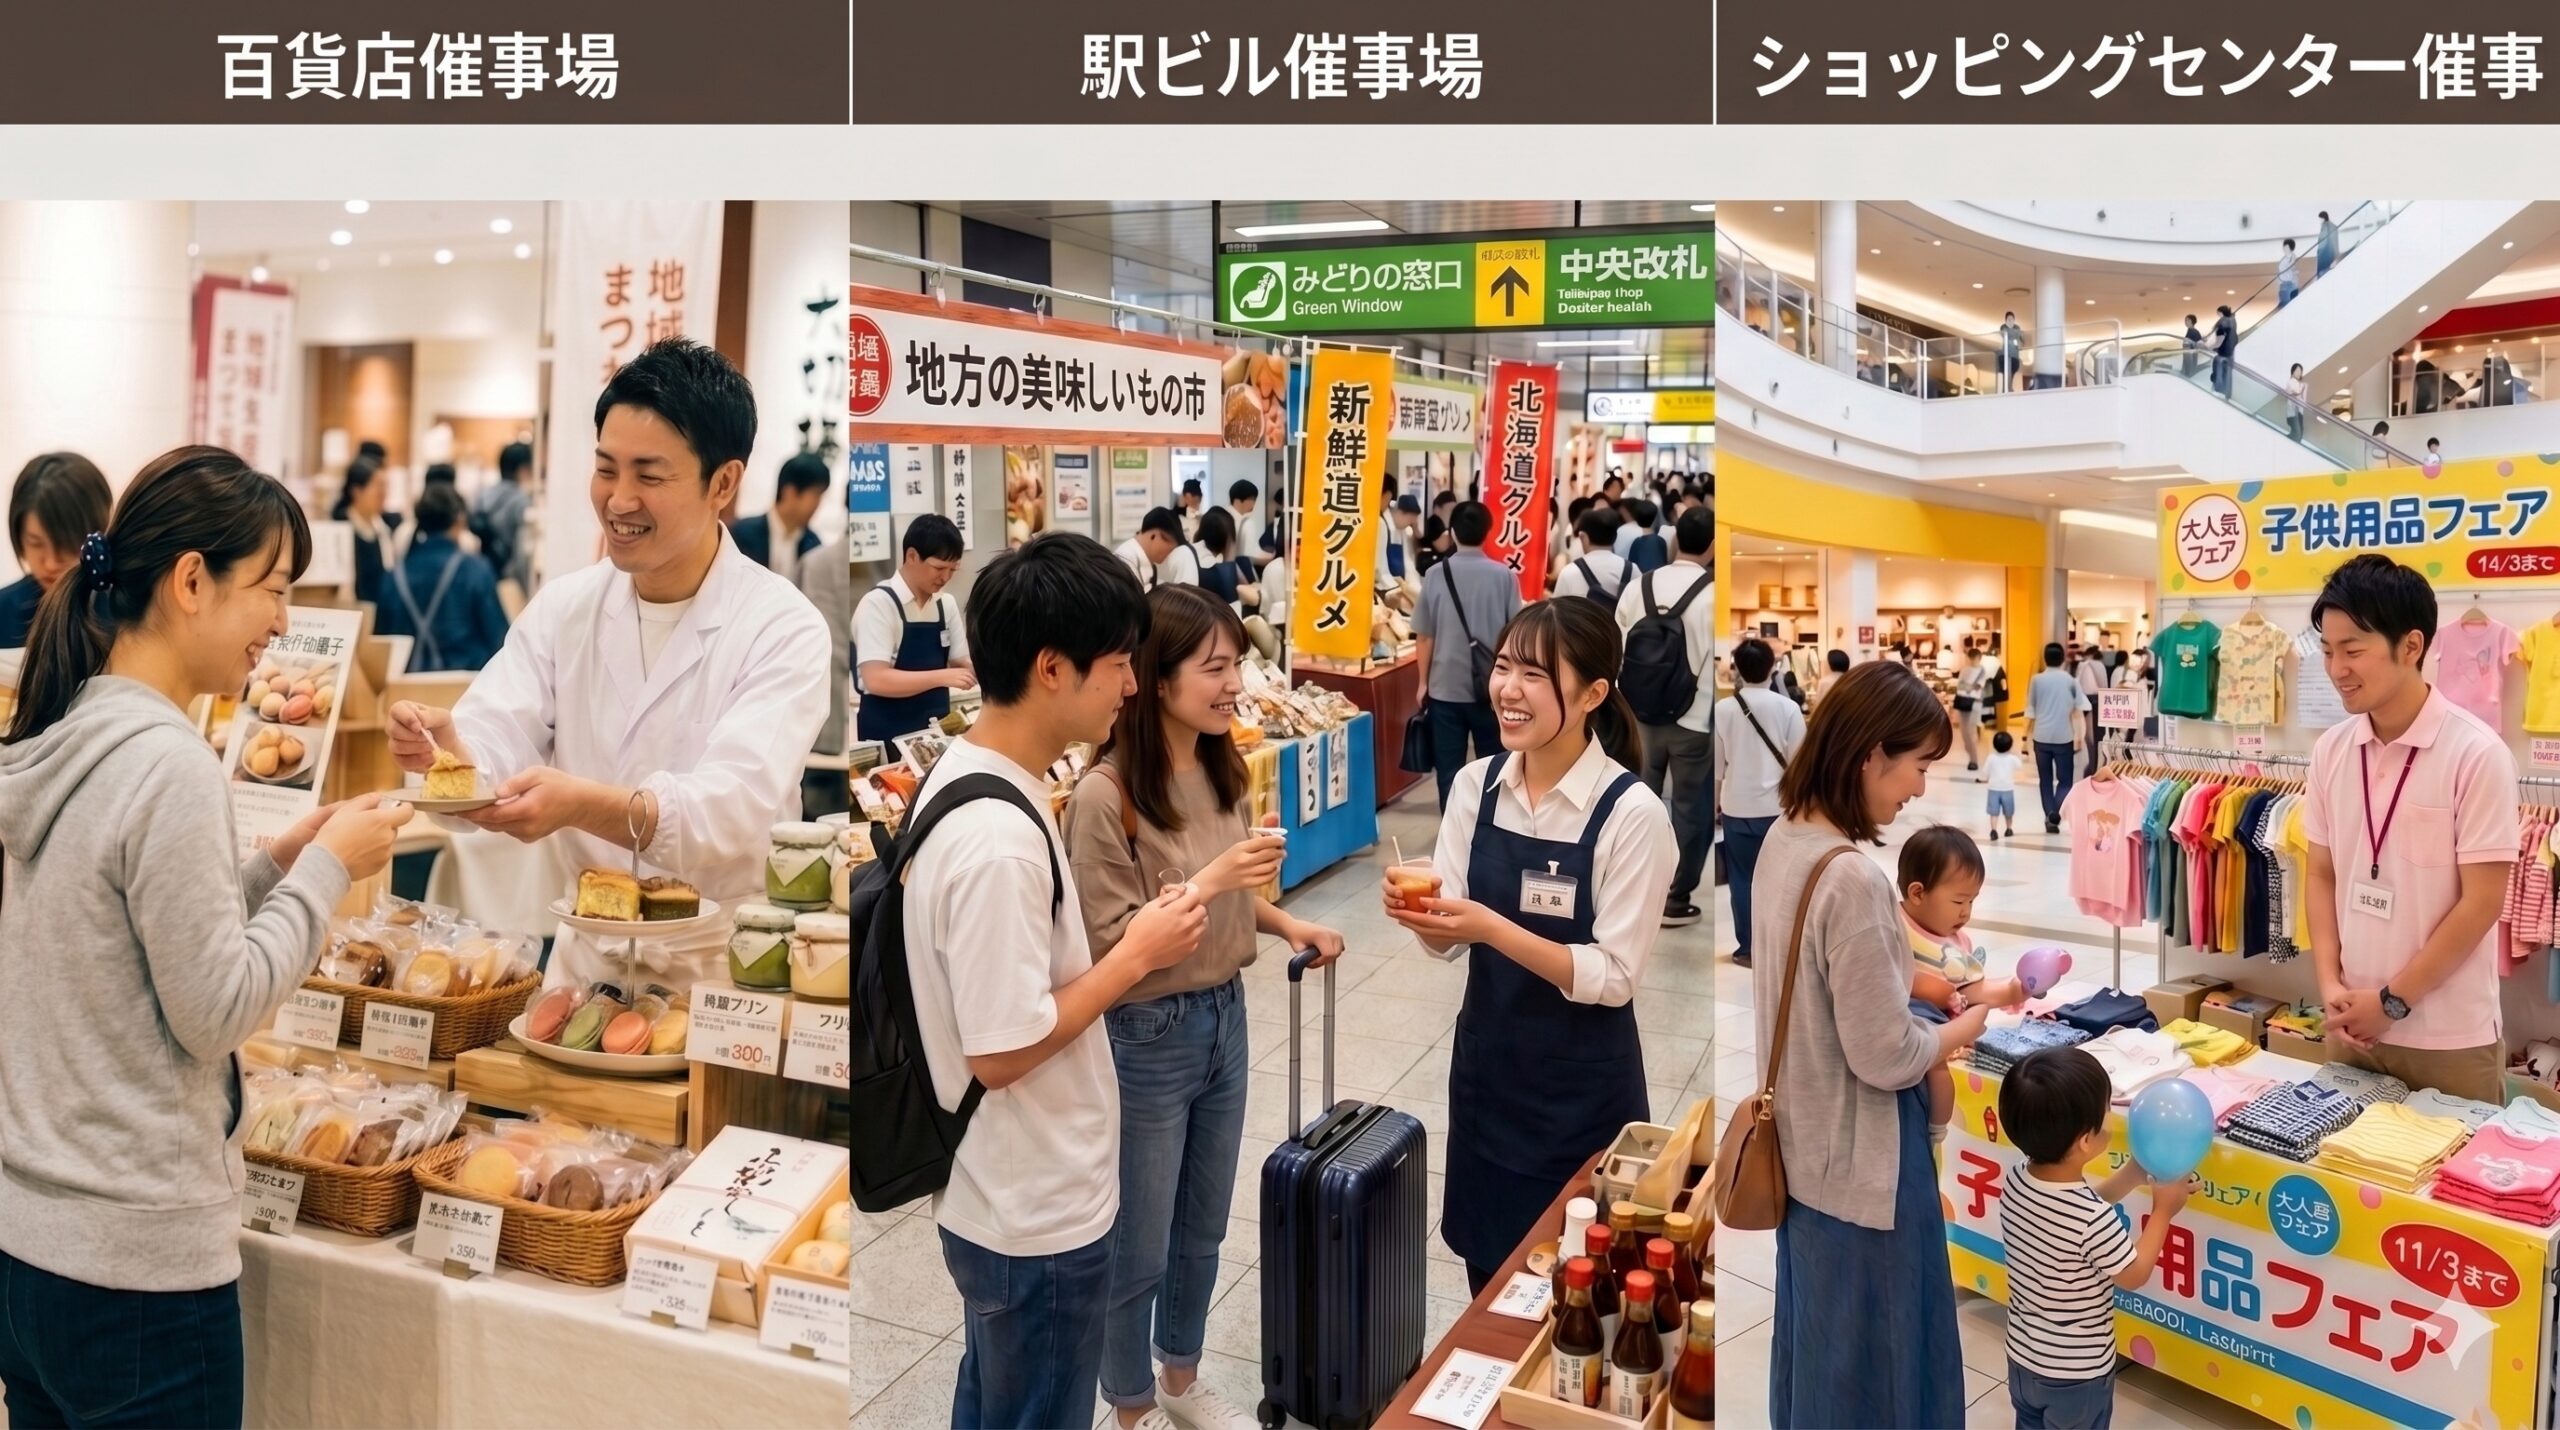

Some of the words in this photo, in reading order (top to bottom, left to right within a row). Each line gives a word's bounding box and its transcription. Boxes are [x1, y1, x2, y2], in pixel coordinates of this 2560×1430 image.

[1292, 258, 1462, 294] みどりの窓口
[1560, 243, 1708, 283] 中央改札
[1292, 300, 1337, 315] Green
[1341, 297, 1403, 314] Window
[905, 340, 1206, 421] 地方の美味しいもの市
[1498, 380, 1544, 571] 北海道グルメ
[1316, 381, 1371, 629] 新鮮道グルメ
[2181, 512, 2240, 543] 大人気
[2262, 490, 2549, 553] 子供用品フェア
[2187, 540, 2237, 567] フェア
[2477, 552, 2556, 573] 14/3まで
[1957, 1150, 2461, 1373] 子用品フェア
[2394, 1236, 2510, 1298] 11/3まで
